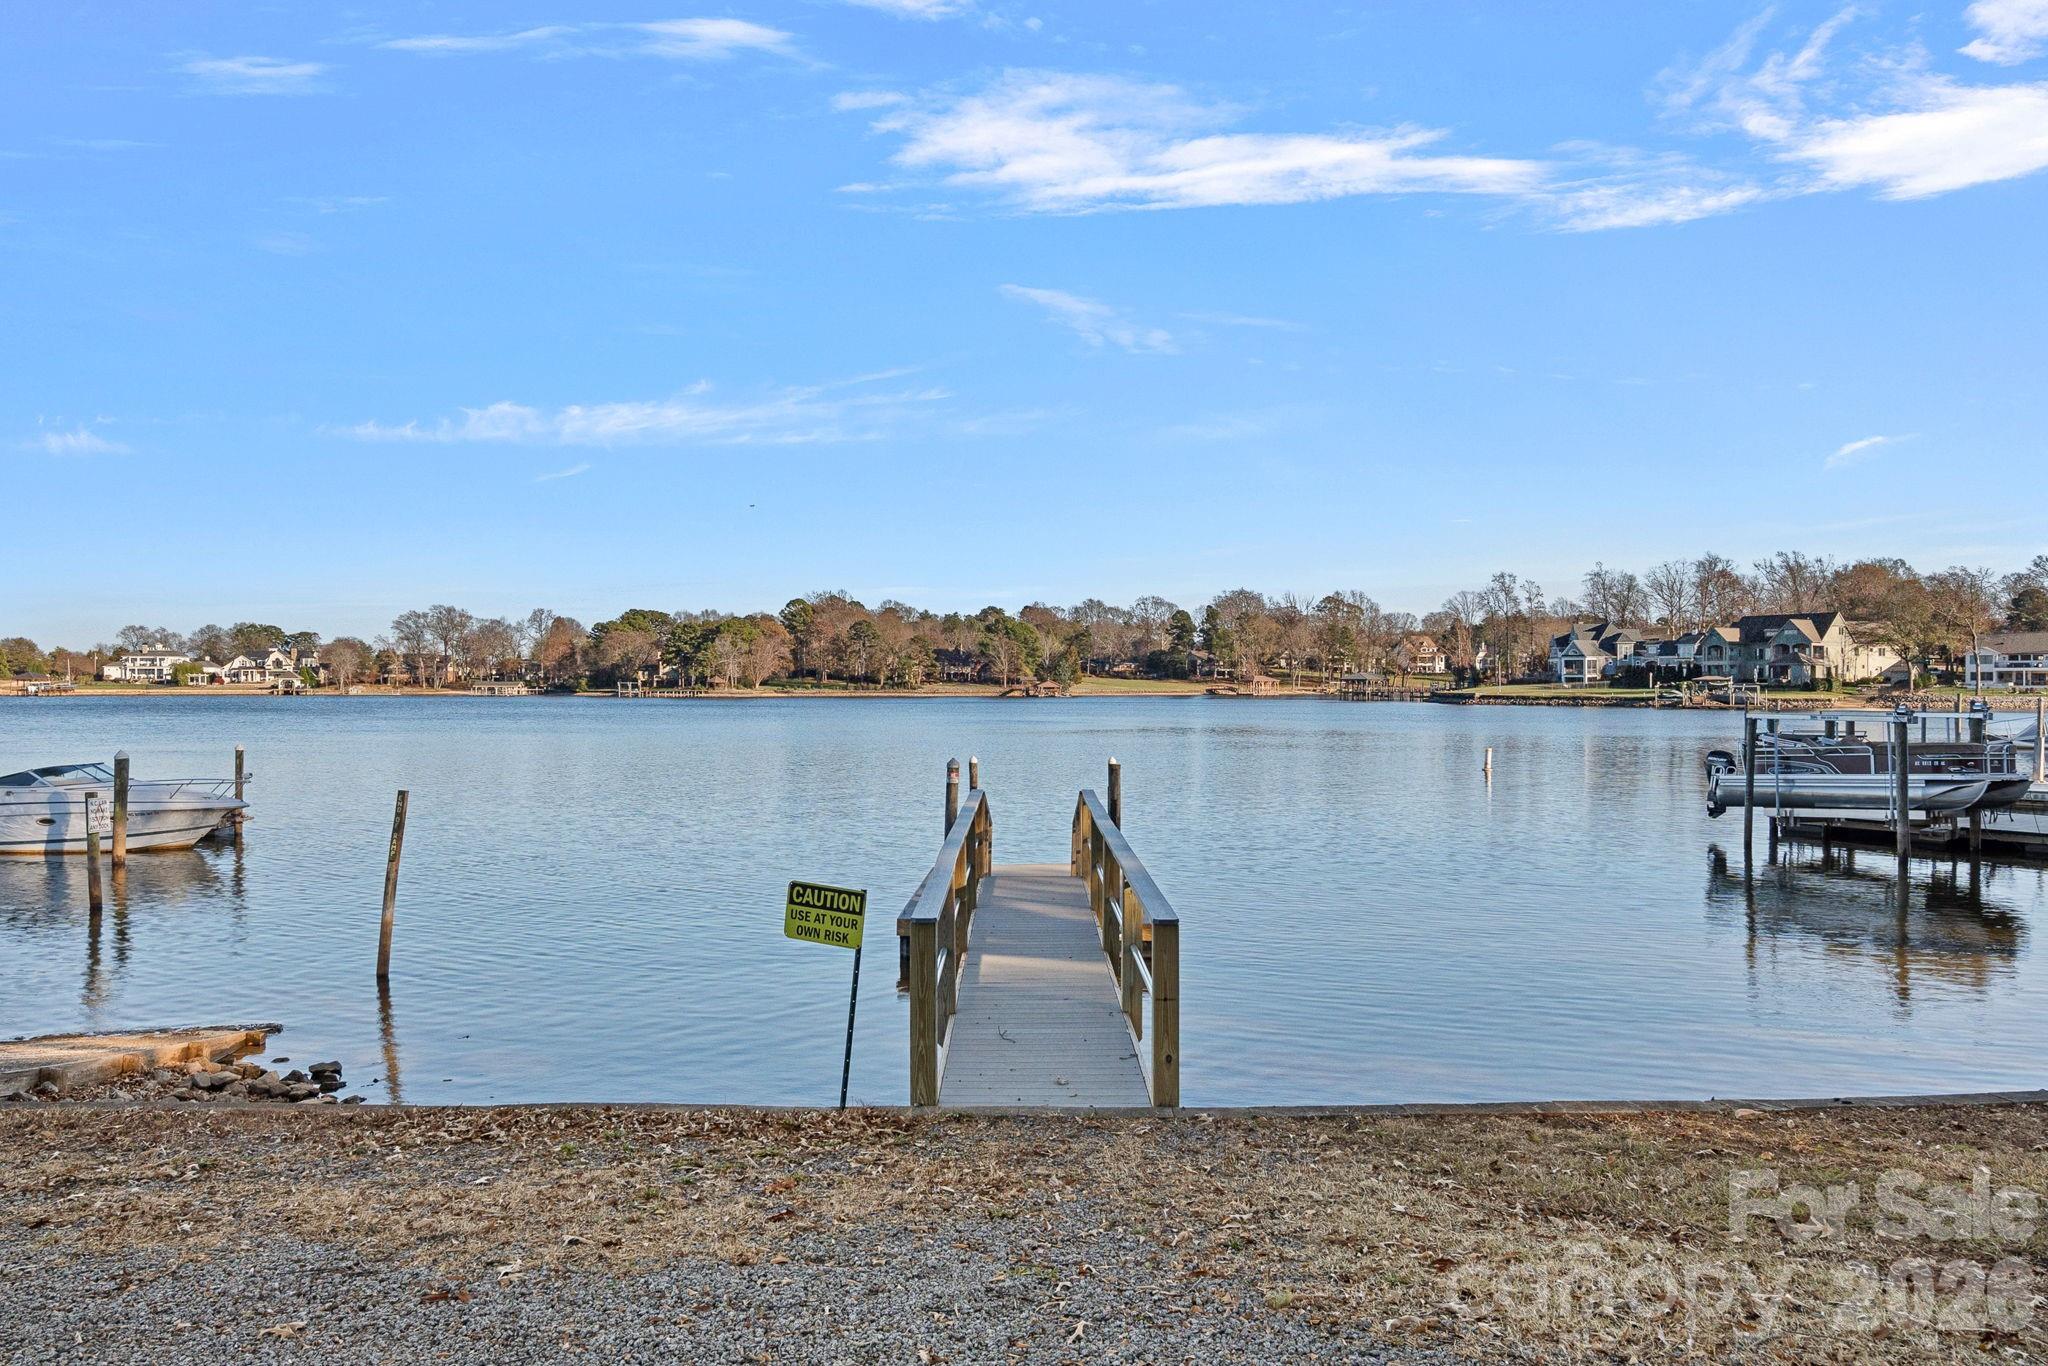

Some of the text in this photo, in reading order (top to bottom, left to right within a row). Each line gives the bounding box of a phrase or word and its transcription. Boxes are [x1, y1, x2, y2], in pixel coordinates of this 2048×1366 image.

[792, 886, 861, 912] CAUTION
[790, 909, 858, 930] USE AT YOUR
[796, 925, 849, 944] OWN RISK
